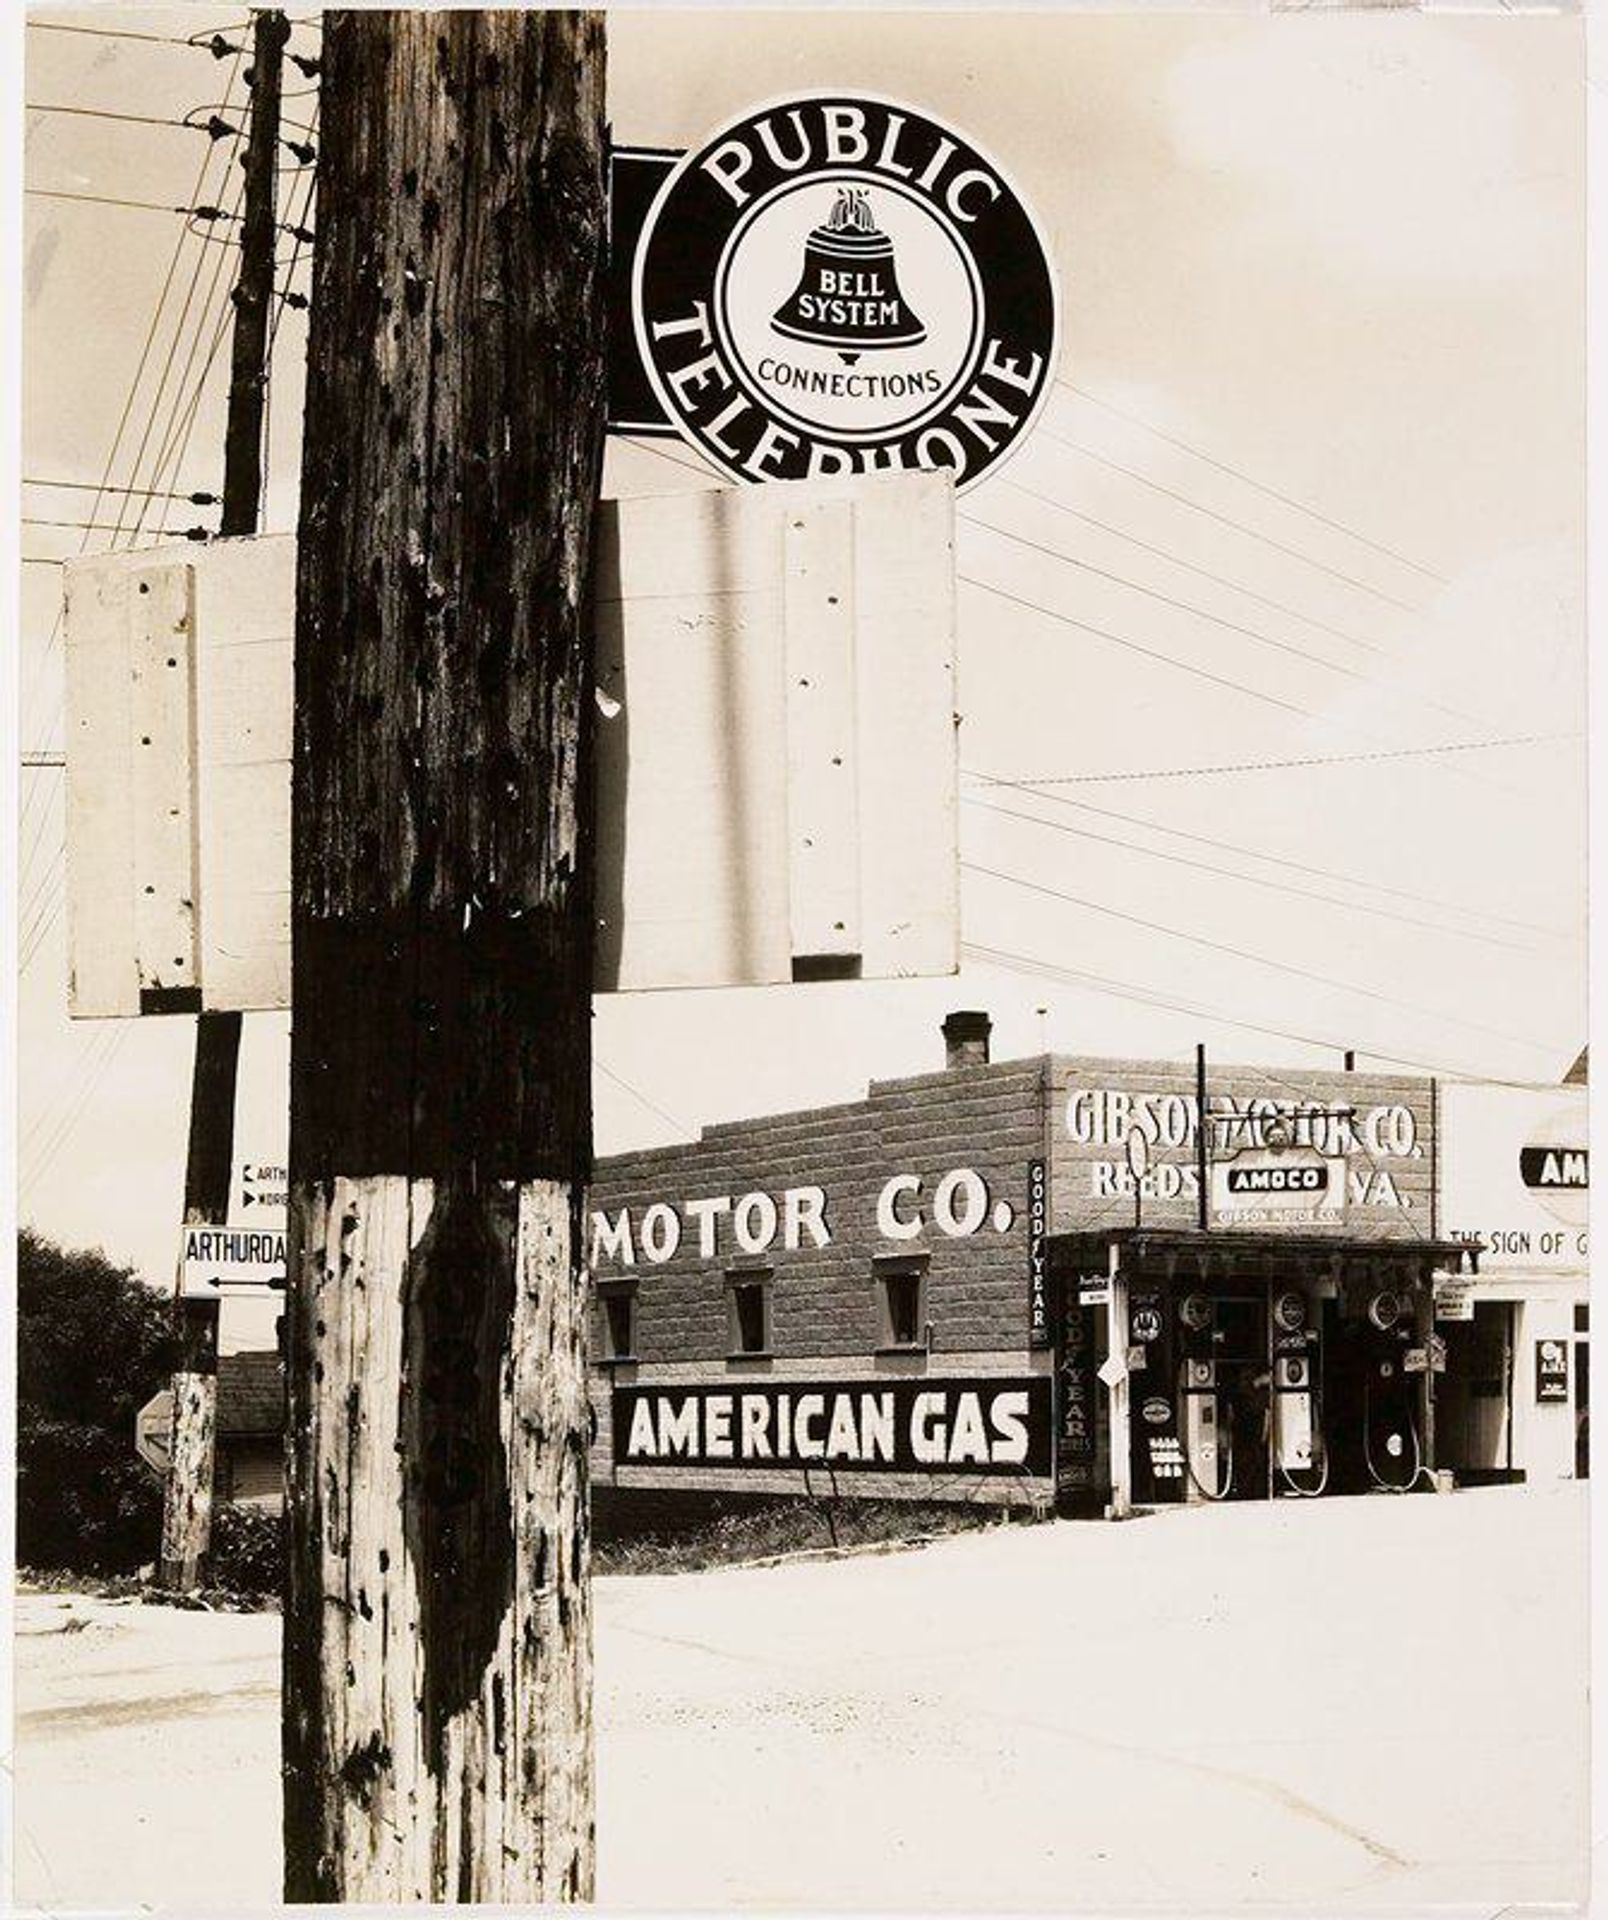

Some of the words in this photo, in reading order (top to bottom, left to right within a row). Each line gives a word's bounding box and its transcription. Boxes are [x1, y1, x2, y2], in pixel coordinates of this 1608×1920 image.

[701, 106, 1002, 222] PUBLIC
[820, 269, 885, 297] BELL
[799, 295, 900, 326] SYSTEM
[651, 300, 1044, 482] TELEPHONE
[757, 357, 943, 398] CONNECTIONS
[1366, 1105, 1425, 1160] CO.
[1233, 1170, 1320, 1190] AMOCO
[1540, 1152, 1588, 1184] AM
[591, 1185, 832, 1267] MOTOR
[876, 1168, 1014, 1240] CO.
[185, 1232, 285, 1264] ARTHURDA
[1490, 1231, 1531, 1254] SIGN
[1540, 1233, 1566, 1254] OF
[626, 1393, 896, 1464] AMERICAN
[909, 1391, 1030, 1465] GAS
